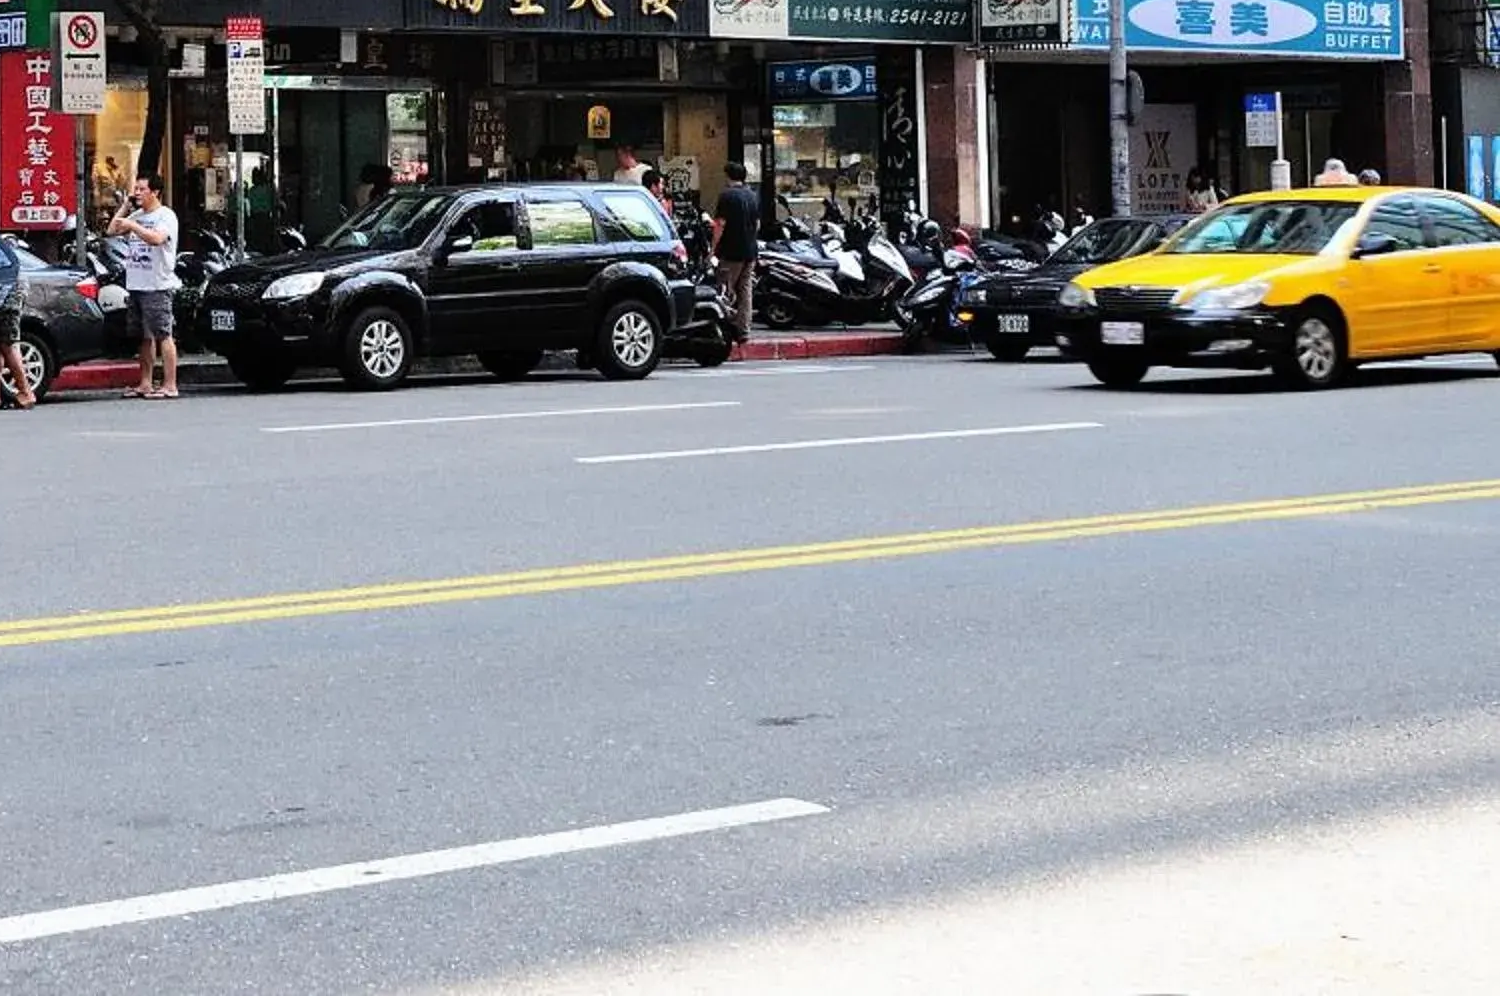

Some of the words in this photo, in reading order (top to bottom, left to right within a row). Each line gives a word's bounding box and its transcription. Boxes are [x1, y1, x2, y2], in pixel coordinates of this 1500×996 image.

[889, 8, 968, 26] 2541-2121
[1175, 1, 1269, 37] 喜美
[1324, 0, 1392, 28] 自助餐
[1325, 33, 1392, 50] BUFFET
[23, 55, 52, 165] 中國工藝
